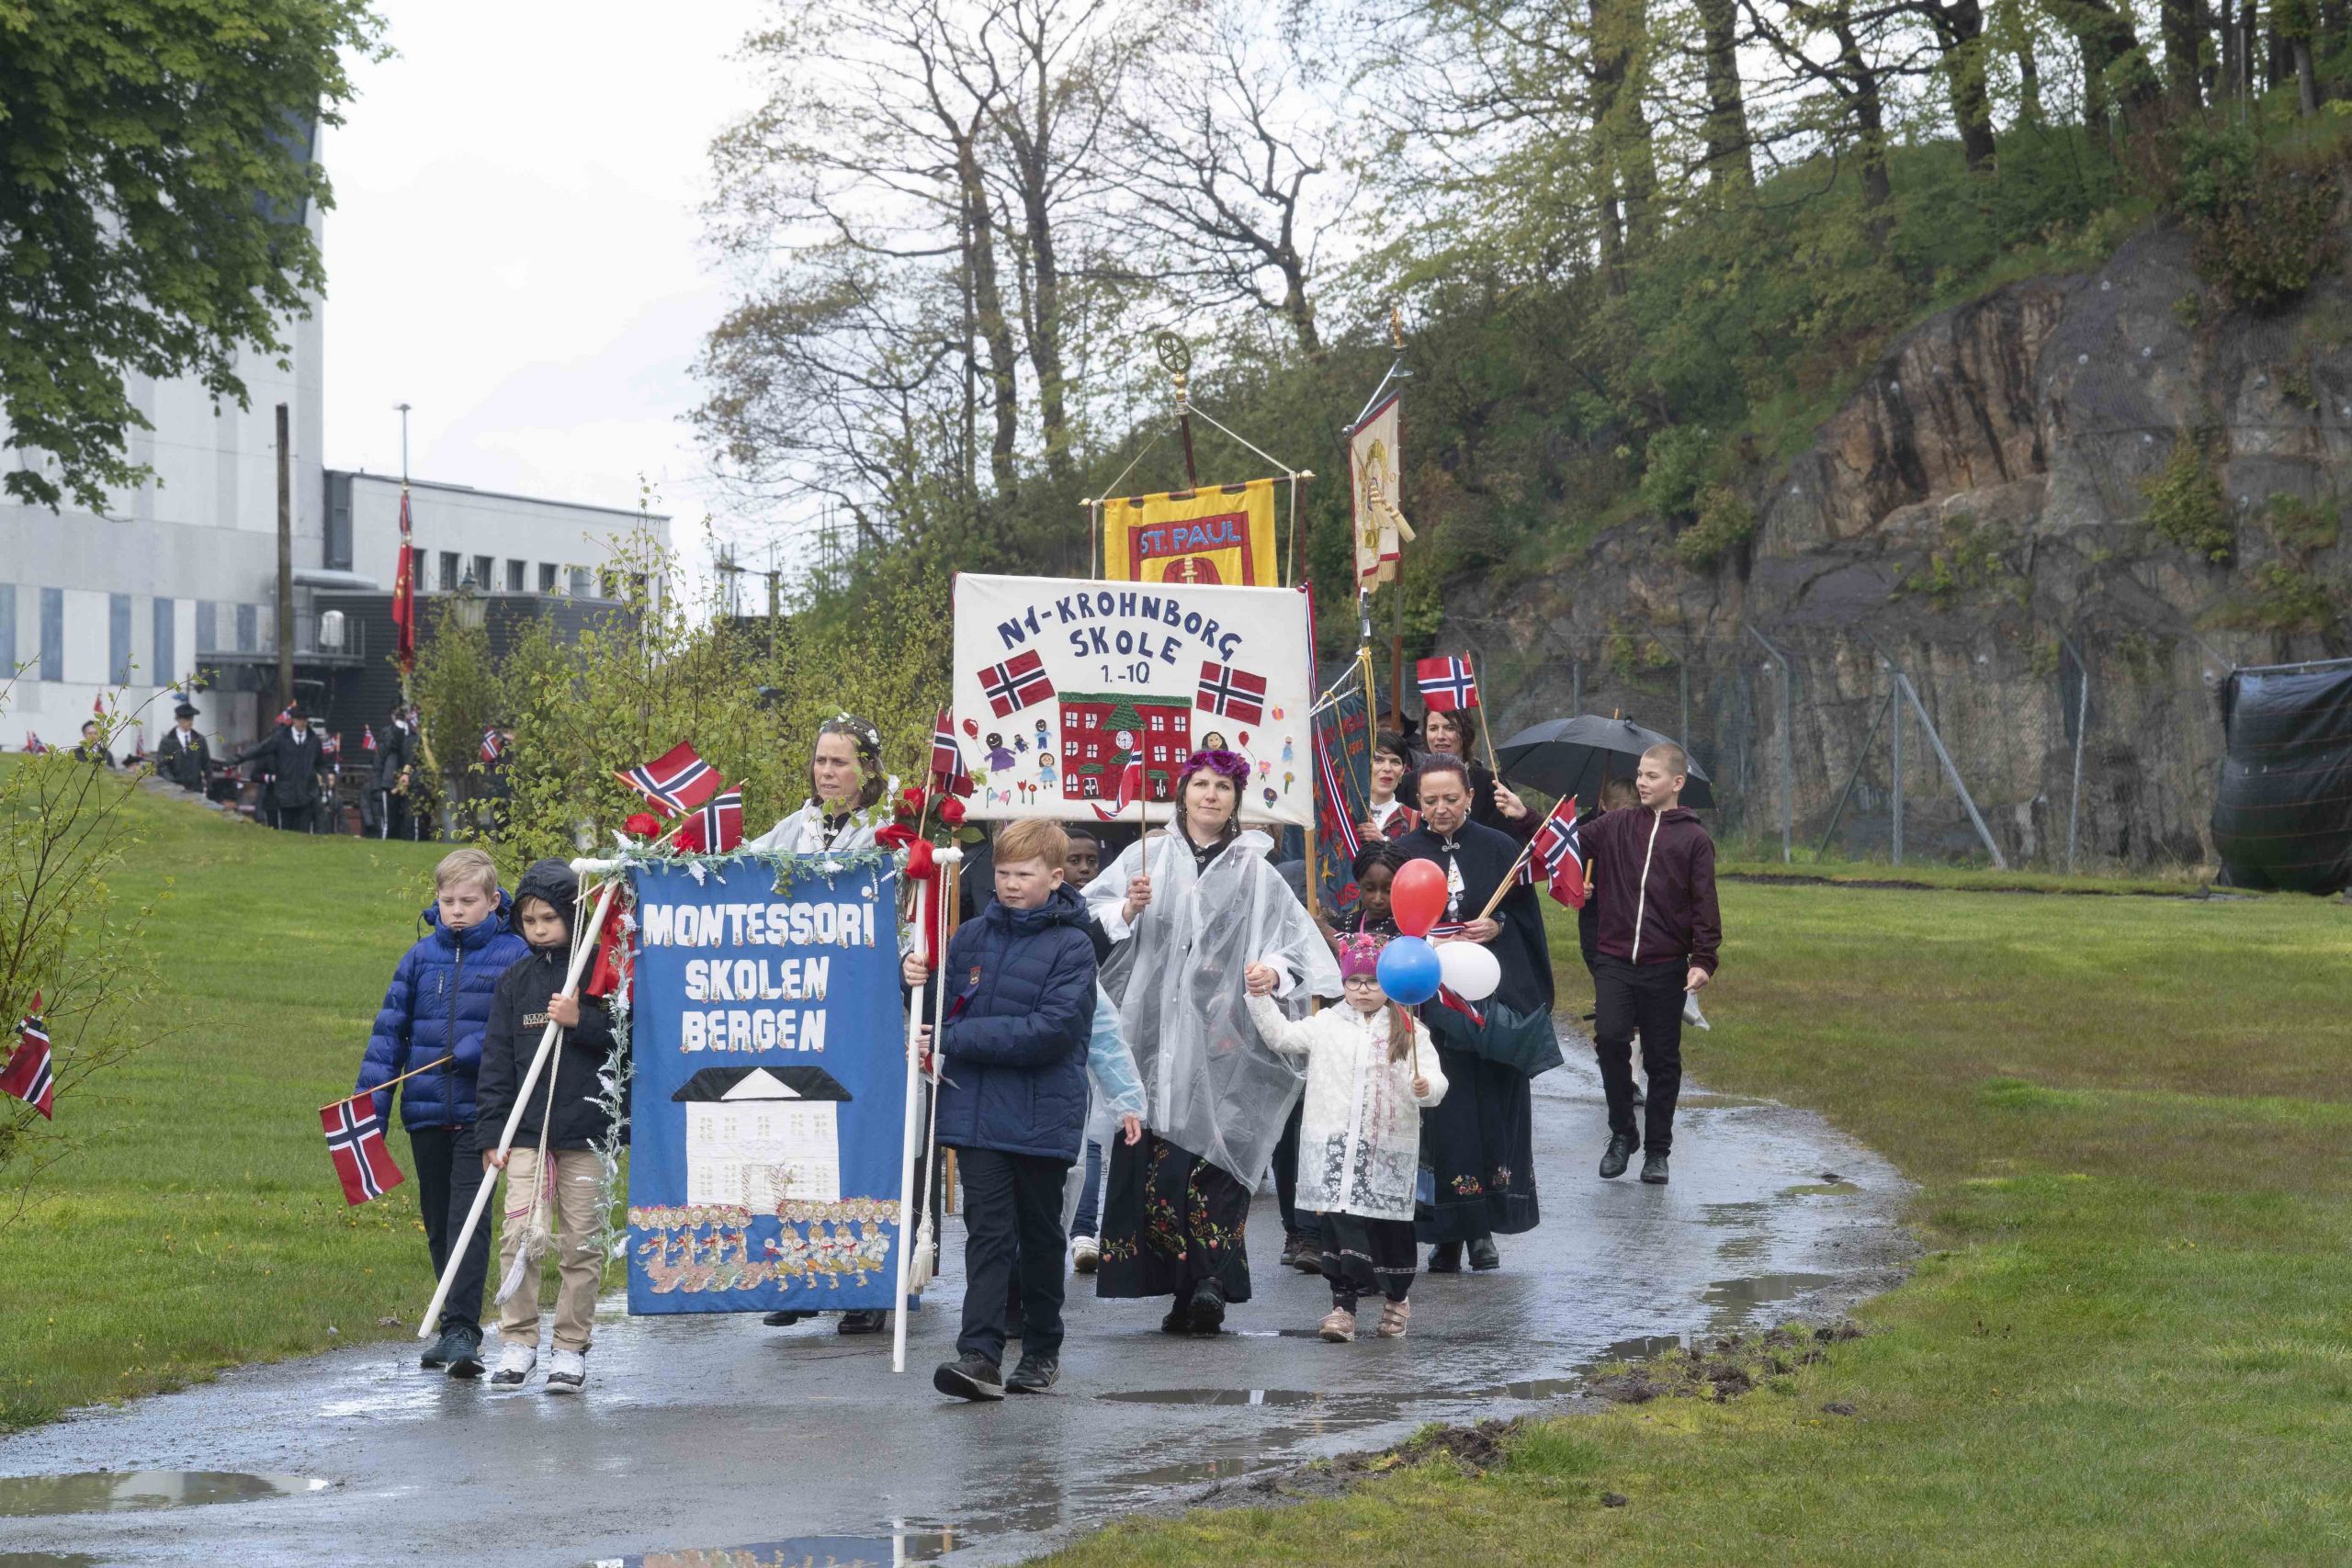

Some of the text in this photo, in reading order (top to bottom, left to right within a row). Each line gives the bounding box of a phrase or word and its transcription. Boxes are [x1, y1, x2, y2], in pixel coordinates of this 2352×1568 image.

[1141, 521, 1241, 554] ST. PAUL
[997, 592, 1242, 662] NY-KROHNBORG
[1069, 626, 1182, 665] SKOLE
[643, 902, 875, 948] MONTESSORI
[685, 956, 830, 1002] SKOLEN
[523, 1012, 550, 1025] NAPA
[681, 1009, 827, 1054] BERGEN
